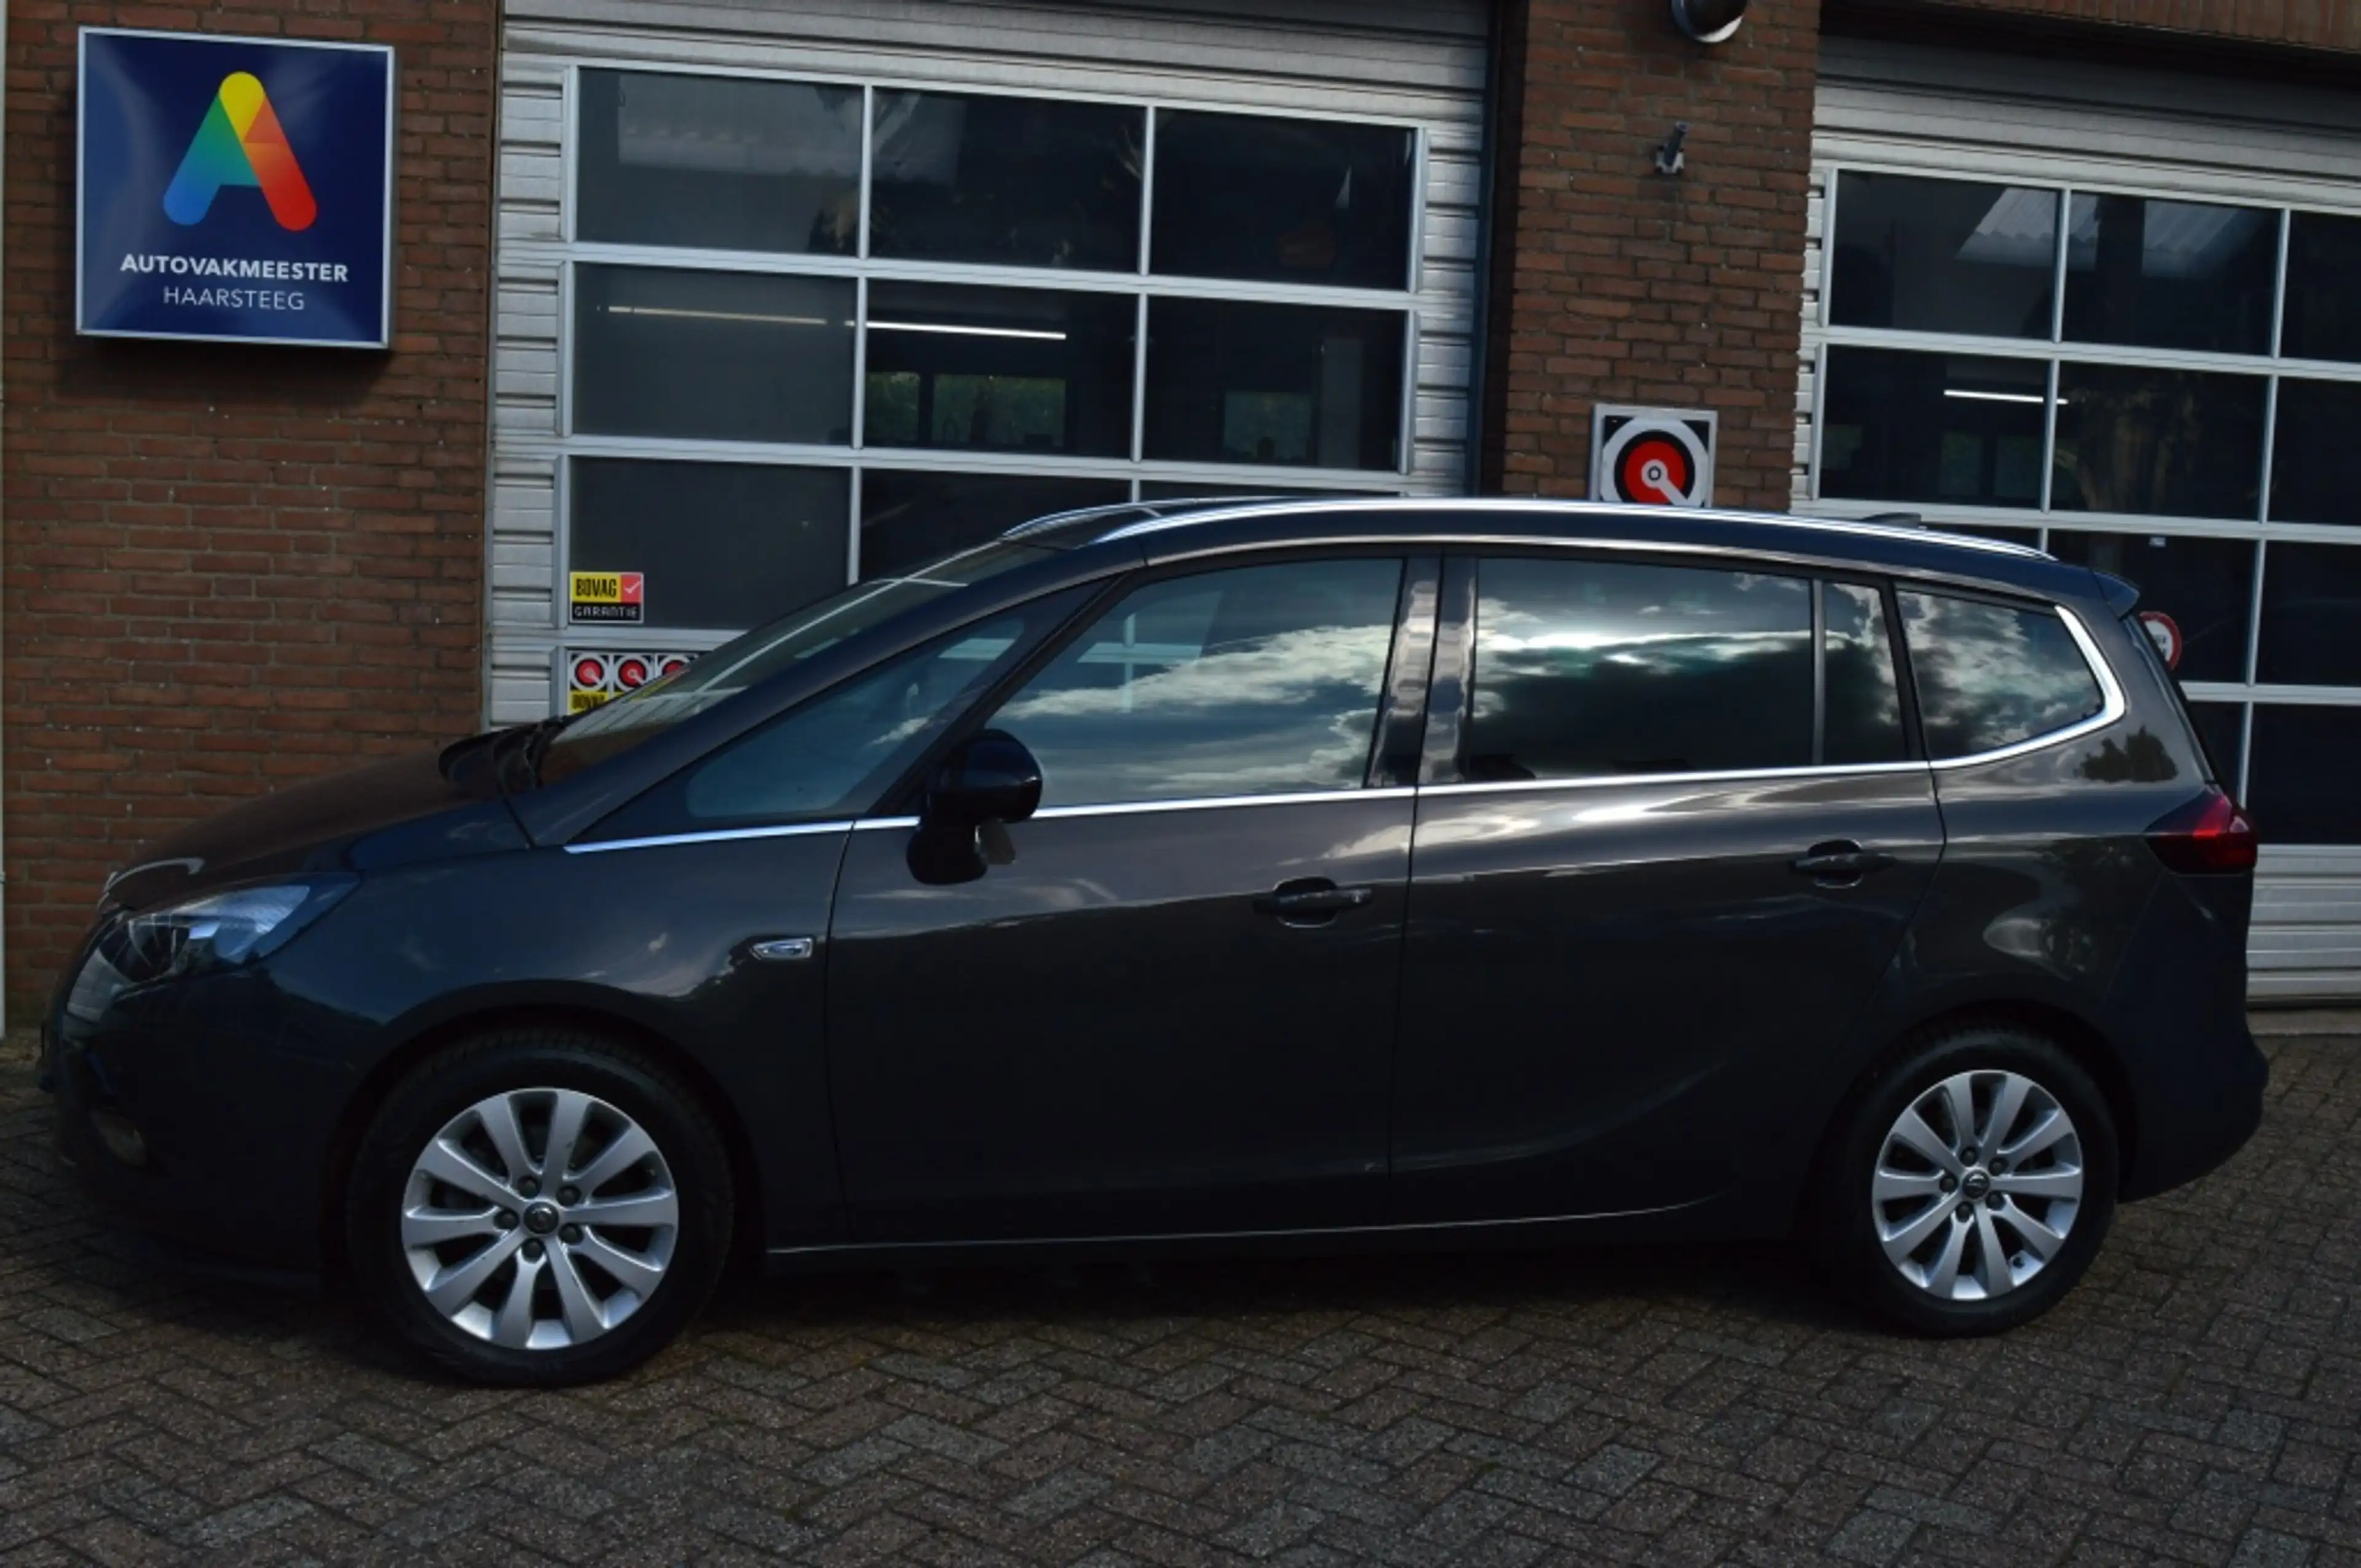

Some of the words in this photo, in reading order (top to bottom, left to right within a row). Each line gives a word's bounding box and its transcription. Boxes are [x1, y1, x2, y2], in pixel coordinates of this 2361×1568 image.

[120, 253, 349, 282] AUTOVAKMEESTER
[163, 286, 305, 311] HAARSTEEG
[576, 579, 617, 598] BOVAG
